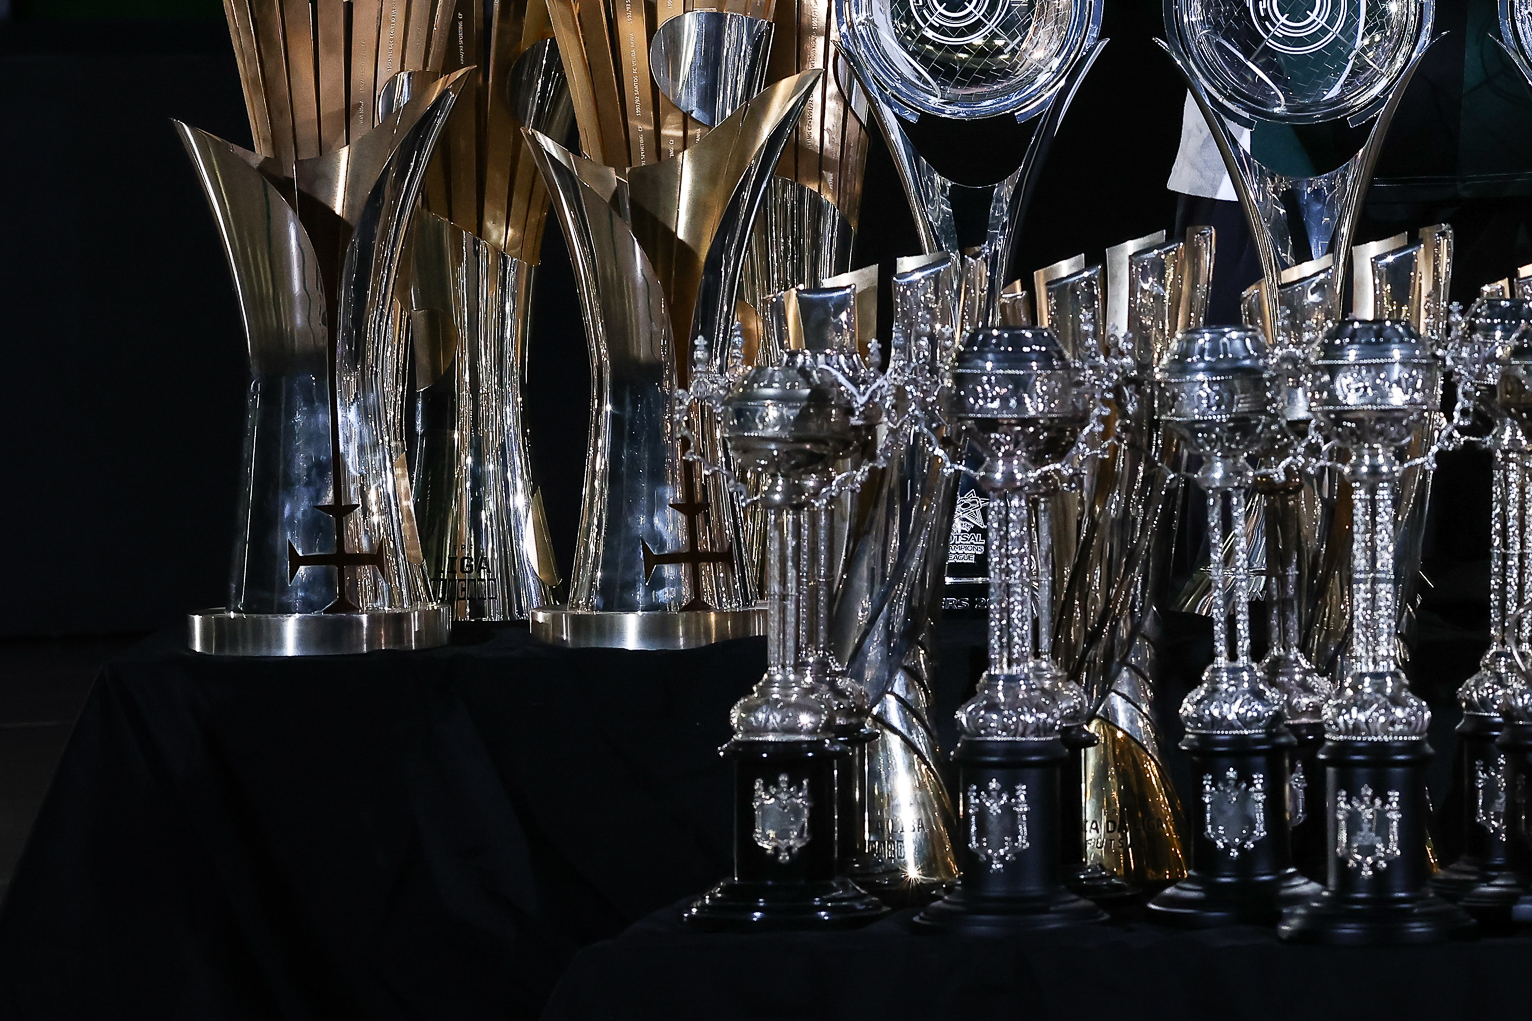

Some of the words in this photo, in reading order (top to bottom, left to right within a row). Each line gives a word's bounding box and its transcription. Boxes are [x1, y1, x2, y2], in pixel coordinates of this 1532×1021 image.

[951, 533, 985, 544] TSAL
[949, 545, 985, 554] AMPIONS
[948, 555, 975, 563] EAGUE
